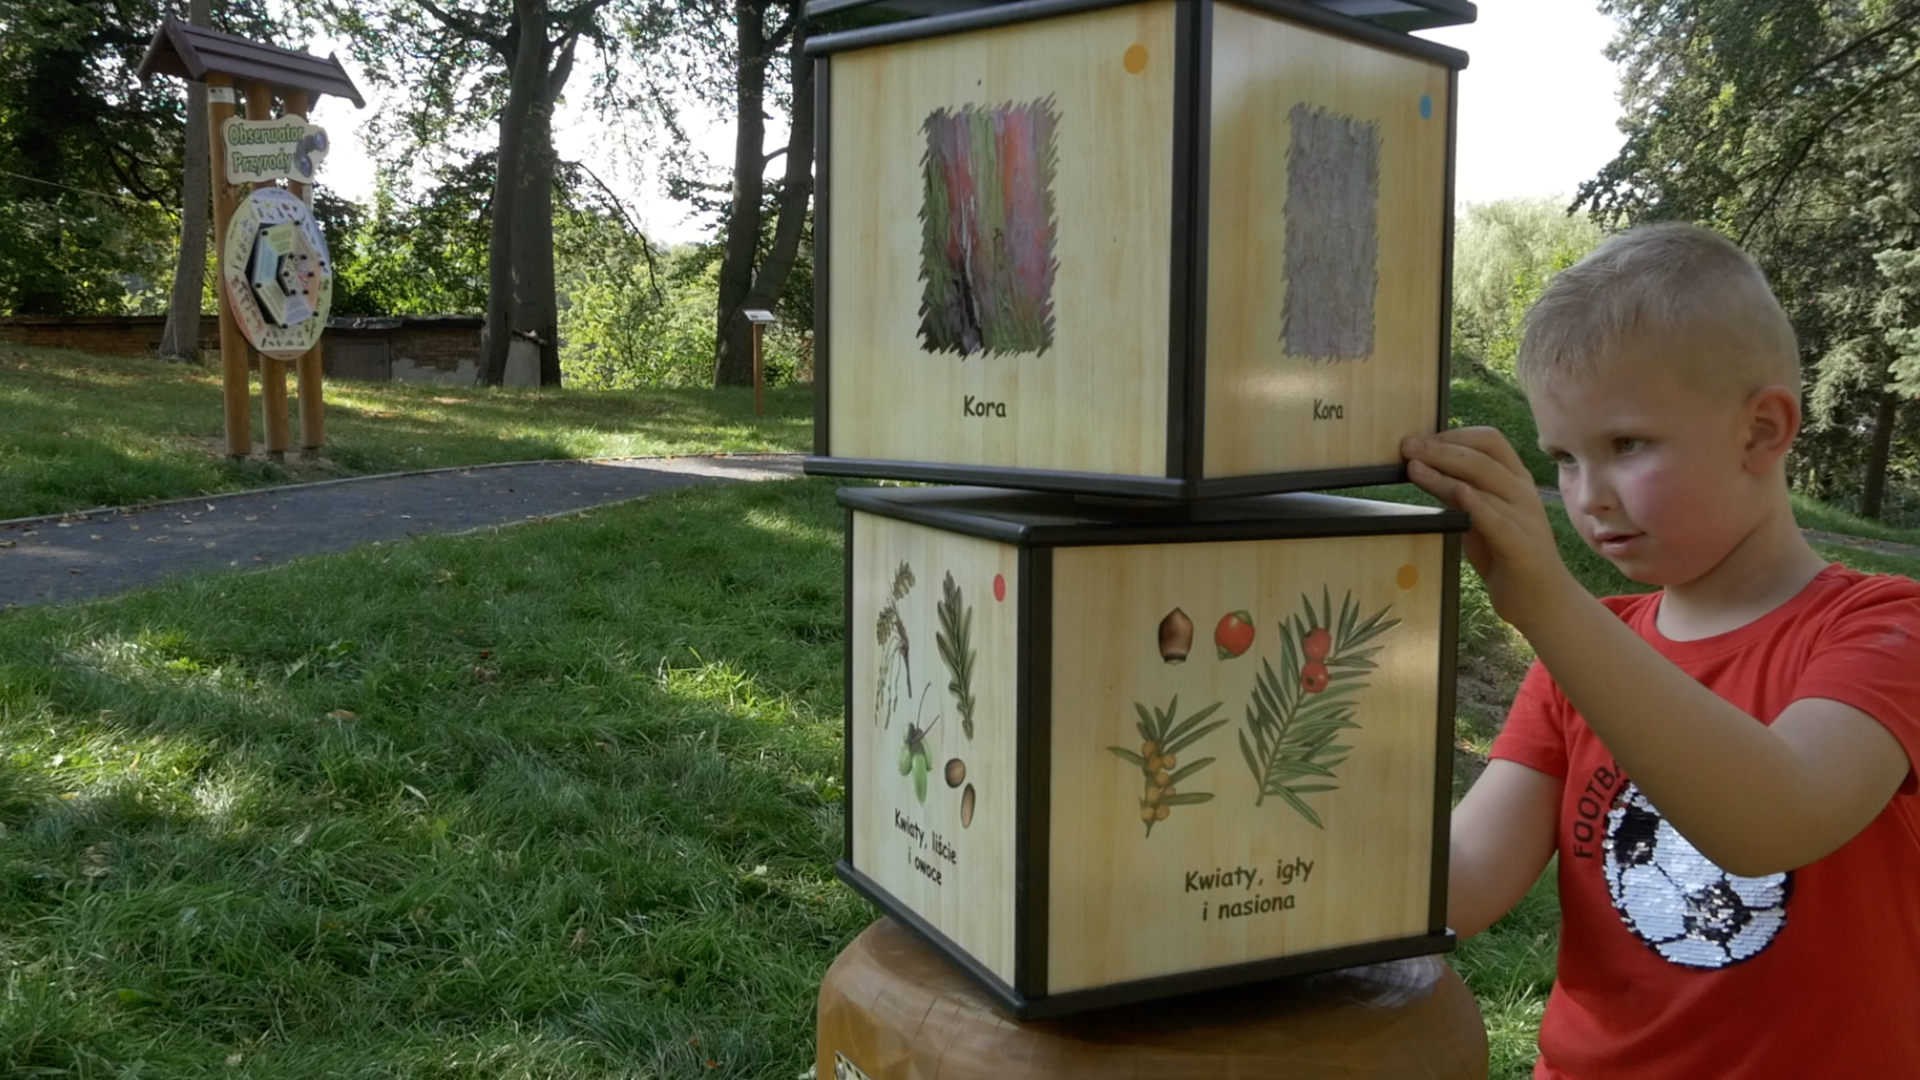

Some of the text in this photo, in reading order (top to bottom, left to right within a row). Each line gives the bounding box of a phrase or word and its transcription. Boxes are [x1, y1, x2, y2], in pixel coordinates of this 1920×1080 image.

[228, 122, 305, 147] Obserwator
[231, 147, 293, 177] Przyrody
[963, 394, 1007, 418] Kora
[1313, 398, 1344, 421] Kora
[894, 807, 958, 866] Kwiaty, liście
[907, 846, 942, 887] i owoce
[1185, 856, 1315, 894] Kwiaty, igły
[1202, 893, 1296, 922] i nasiona
